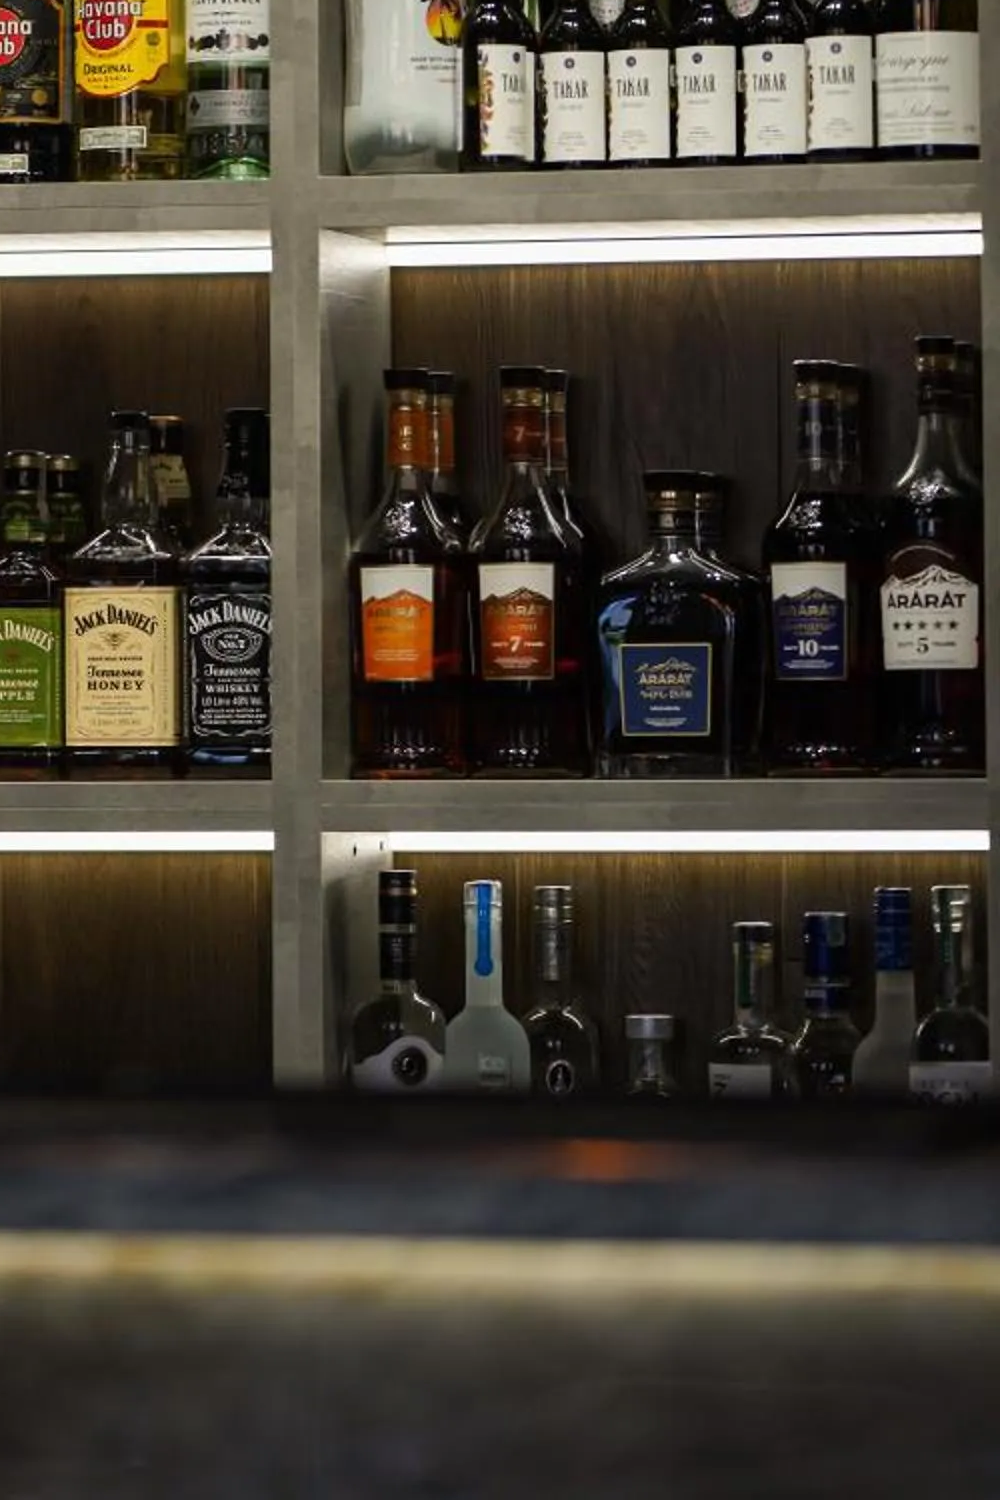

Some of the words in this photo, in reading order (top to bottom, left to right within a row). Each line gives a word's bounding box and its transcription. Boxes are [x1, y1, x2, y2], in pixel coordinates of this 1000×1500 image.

[85, 18, 127, 41] Club
[83, 63, 135, 76] ORIGINAL
[886, 589, 967, 609] ARARAT
[74, 609, 107, 637] JACK
[188, 606, 223, 636] JACK
[509, 635, 523, 652] 7
[797, 639, 819, 658] 10
[916, 636, 930, 654] 5
[87, 680, 146, 691] HONEY
[638, 671, 694, 686] ARARAT
[205, 684, 260, 693] WHISKEY
